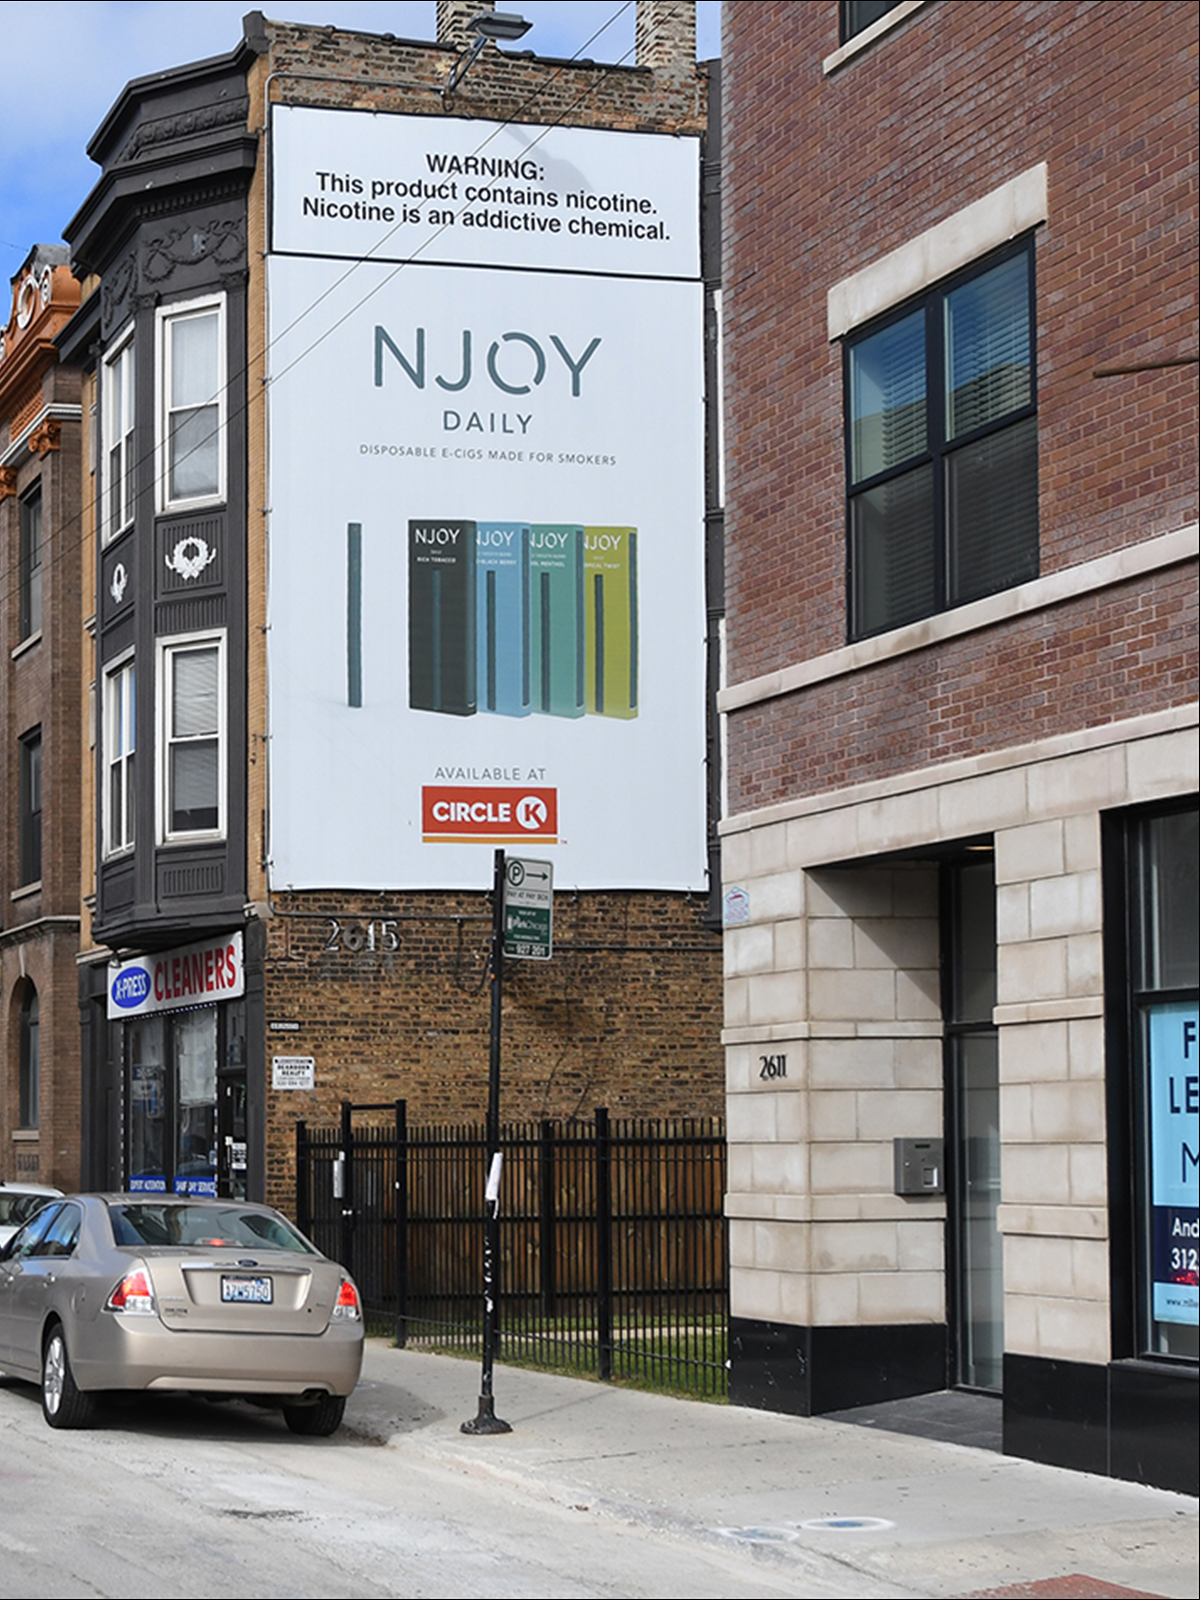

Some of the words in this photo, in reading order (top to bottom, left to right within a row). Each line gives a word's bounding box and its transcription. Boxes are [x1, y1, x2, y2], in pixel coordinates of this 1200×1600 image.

[425, 153, 545, 182] WARNING:
[315, 171, 364, 194] This
[371, 179, 458, 201] product
[464, 185, 559, 208] contains
[566, 190, 658, 215] nicotine.
[302, 196, 395, 223] Nicotine
[402, 203, 421, 225] is
[427, 208, 455, 226] an
[462, 208, 562, 233] addictive
[567, 215, 671, 241] chemical.
[374, 324, 602, 398] NJOY
[442, 410, 533, 434] DAILY
[359, 444, 437, 458] DISPOSABLE
[441, 448, 484, 460] E-CIGS
[488, 450, 524, 462] MADE
[528, 451, 554, 463] FOR
[557, 453, 617, 466] SMOKERS
[414, 528, 460, 545] NJOY
[434, 766, 521, 781] AVAILABLE
[527, 768, 547, 781] AT
[432, 801, 512, 823] CIRCLE
[521, 800, 547, 828] K
[322, 918, 400, 952] 2615
[115, 973, 147, 1001] X-PRESS
[154, 944, 237, 1002] CLEANERS
[759, 1054, 787, 1079] 2611
